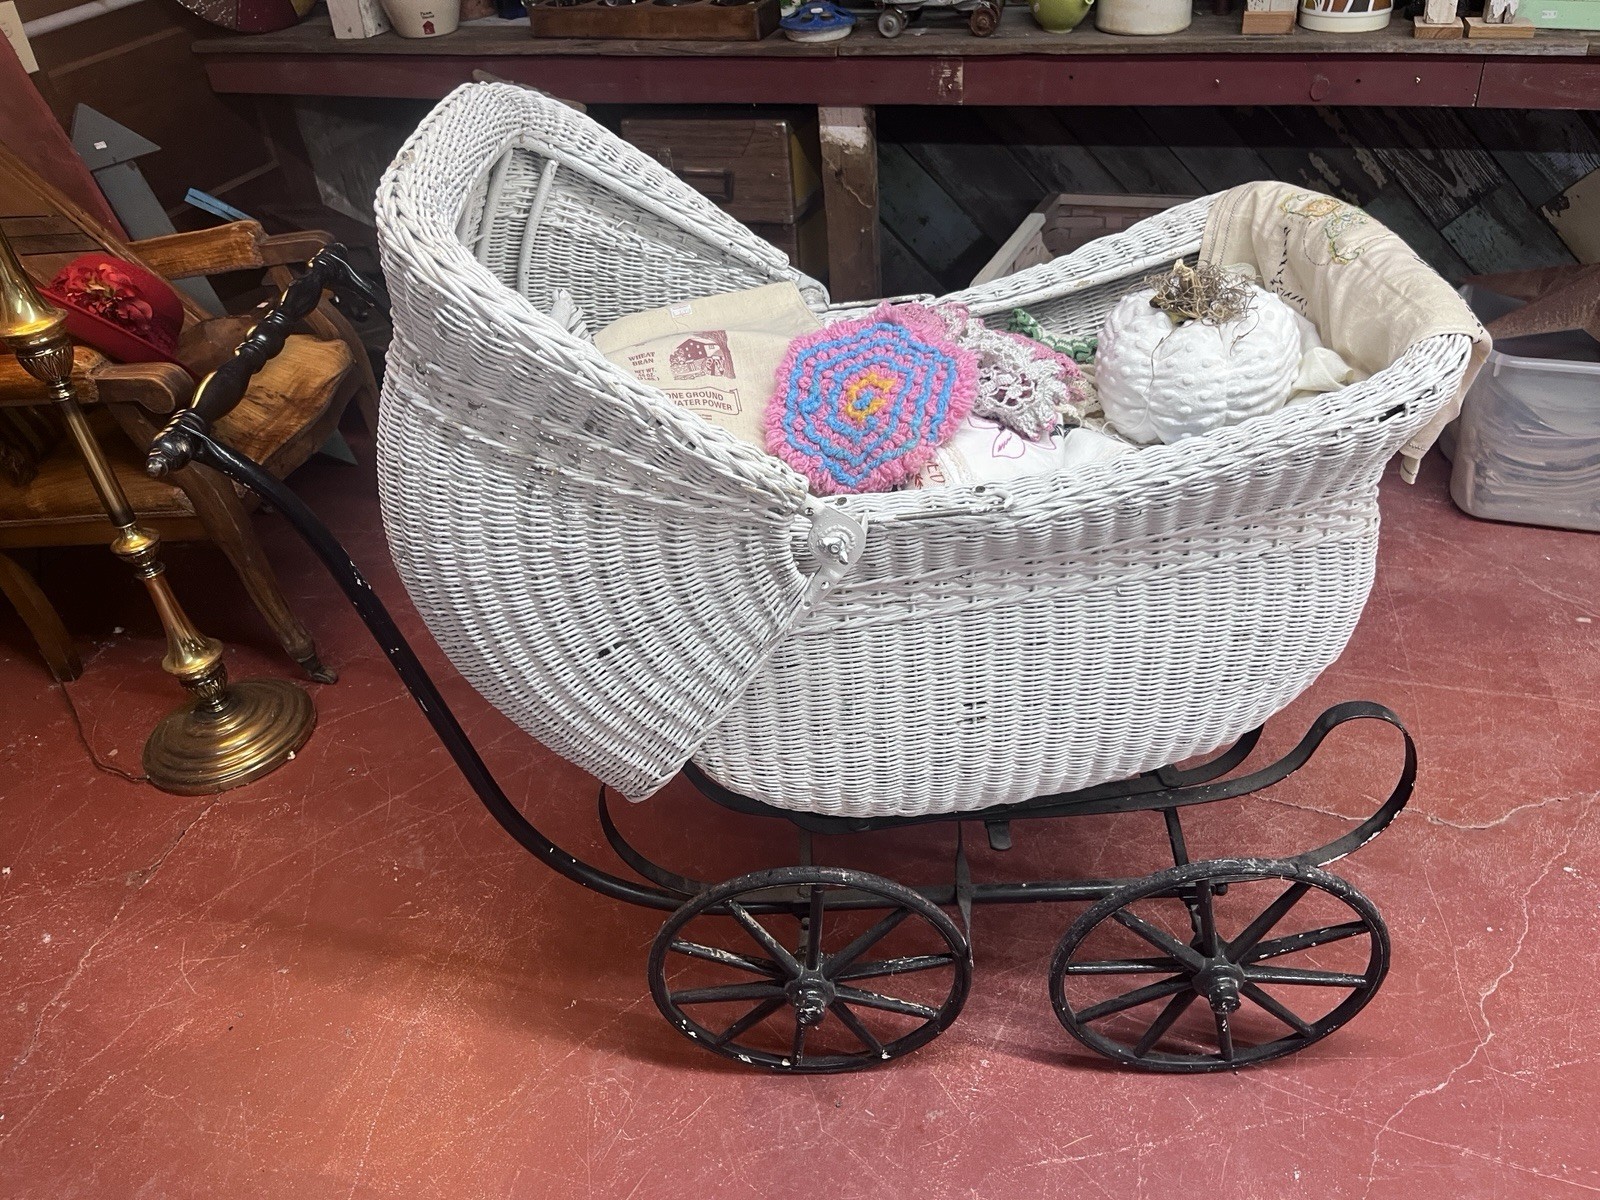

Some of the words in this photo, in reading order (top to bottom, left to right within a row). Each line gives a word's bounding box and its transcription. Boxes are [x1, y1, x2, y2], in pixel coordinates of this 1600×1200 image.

[628, 352, 655, 361] WHEAT
[632, 358, 654, 366] BRAN
[685, 391, 724, 401] GROUND
[702, 399, 733, 411] POWER
